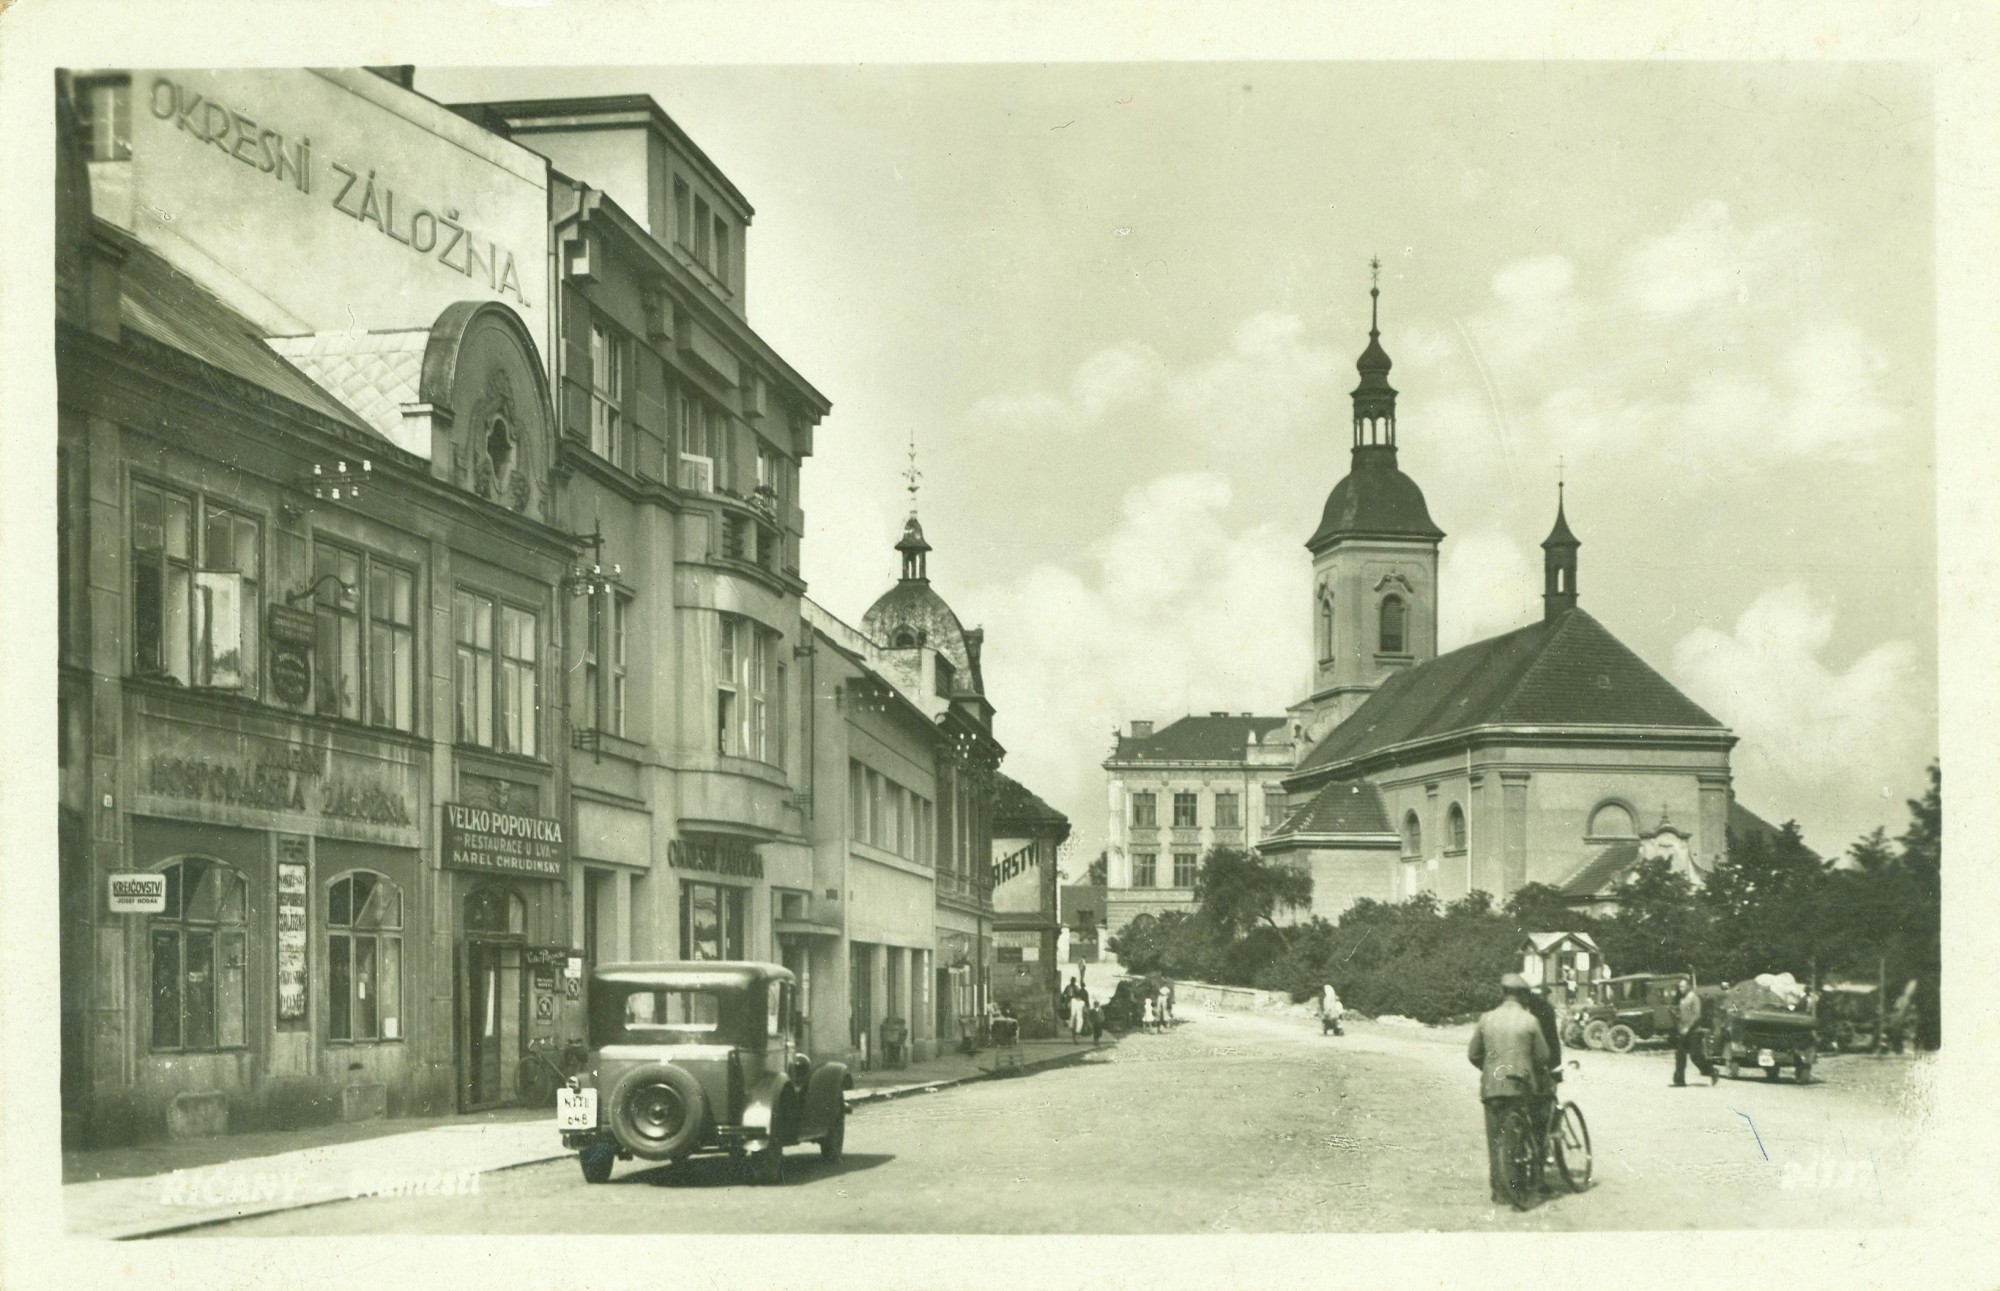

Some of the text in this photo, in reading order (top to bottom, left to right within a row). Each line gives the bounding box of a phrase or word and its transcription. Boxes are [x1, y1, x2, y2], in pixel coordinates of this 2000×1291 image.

[150, 77, 311, 195] OKRESNÍ
[453, 850, 493, 866] KAREL
[464, 833, 551, 858] RESTAURACE U LVA
